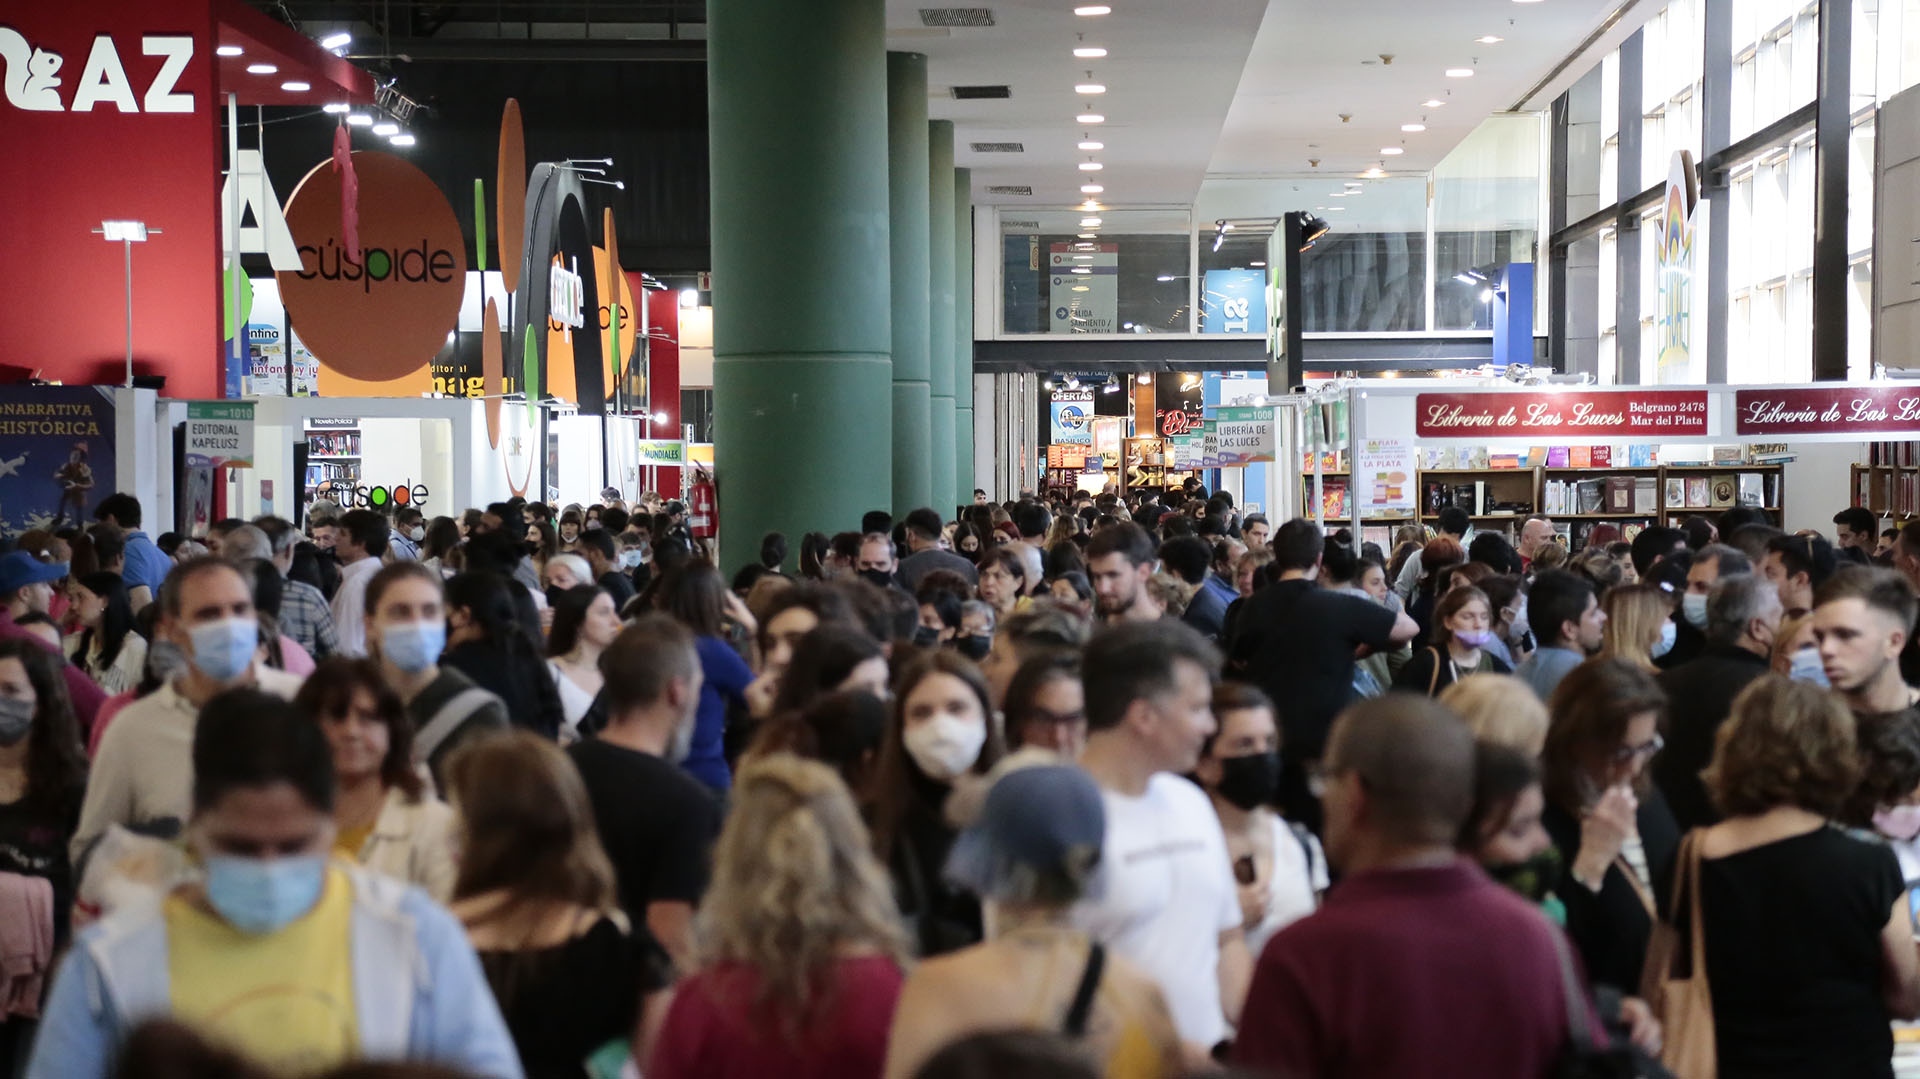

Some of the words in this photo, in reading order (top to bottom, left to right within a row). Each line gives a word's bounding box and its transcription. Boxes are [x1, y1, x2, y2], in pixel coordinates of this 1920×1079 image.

[71, 36, 195, 113] AZ
[1052, 392, 1093, 401] OFERTAS
[230, 408, 253, 418] 1010
[1629, 402, 1677, 414] Belgrano
[1679, 402, 1705, 412] 2478
[1744, 401, 1818, 424] Librería
[1821, 402, 1842, 422] de
[1846, 398, 1888, 422] Las
[1253, 410, 1273, 420] 1008
[1497, 406, 1517, 427] de
[1521, 403, 1563, 427] Las
[1567, 402, 1625, 426] Luces
[1631, 415, 1653, 425] Mar
[1656, 415, 1672, 425] del
[1675, 415, 1703, 425] Plata
[192, 424, 239, 435] EDITORIAL
[1219, 423, 1254, 436] LIBRERÍA
[1256, 424, 1266, 434] DE
[191, 437, 239, 450] KAPELUSZ
[1219, 438, 1234, 448] LAS
[1236, 437, 1260, 447] LUCES
